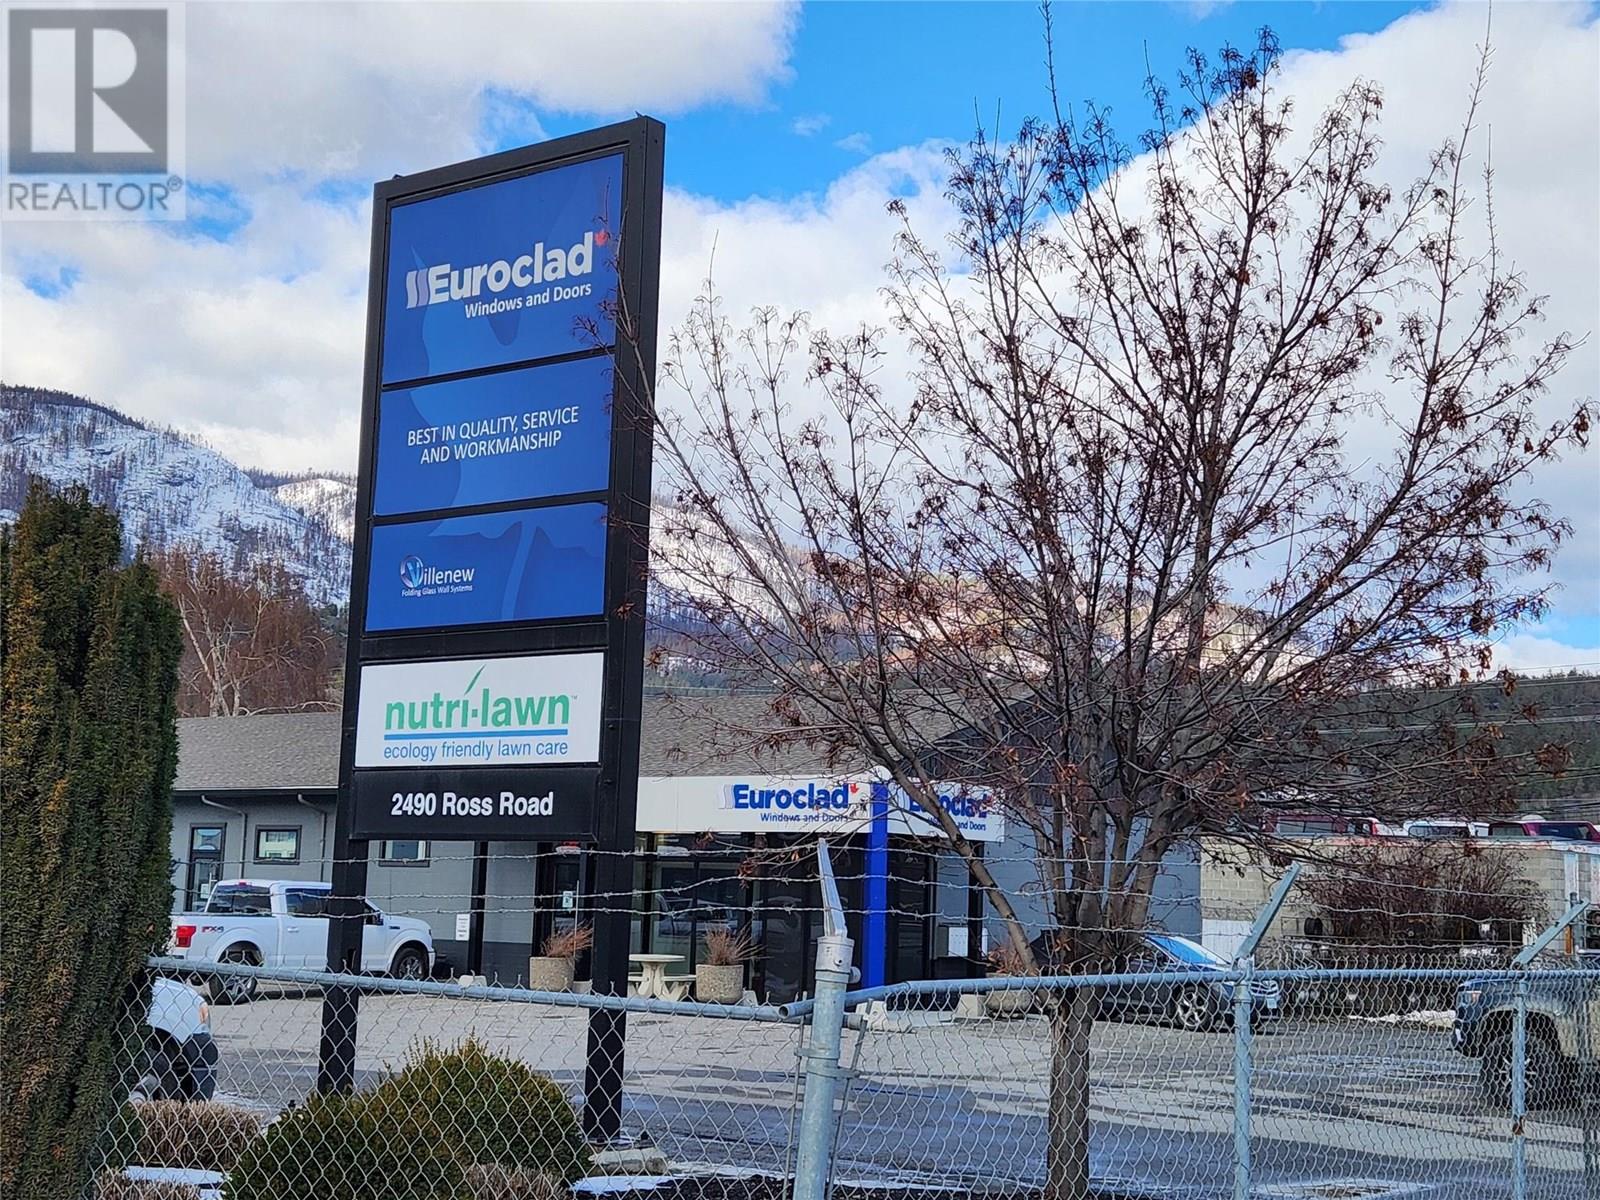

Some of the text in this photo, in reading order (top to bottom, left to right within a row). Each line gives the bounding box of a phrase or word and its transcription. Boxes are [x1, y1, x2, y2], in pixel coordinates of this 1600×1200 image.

[429, 231, 594, 305] Euroclad
[465, 282, 592, 319] Windows and Doors
[407, 407, 579, 446] BEST IN QUALITY, SERVICE
[420, 430, 562, 465] AND WORKMANSHIP
[403, 556, 475, 587] Villenew
[422, 586, 437, 596] Glass
[437, 584, 450, 594] Wall
[383, 741, 568, 762] ecology friendly lawn care
[391, 791, 554, 816] 2490 Ross Road
[733, 783, 849, 809] Euroclad
[760, 813, 800, 822] Windows
[802, 812, 819, 822] and
